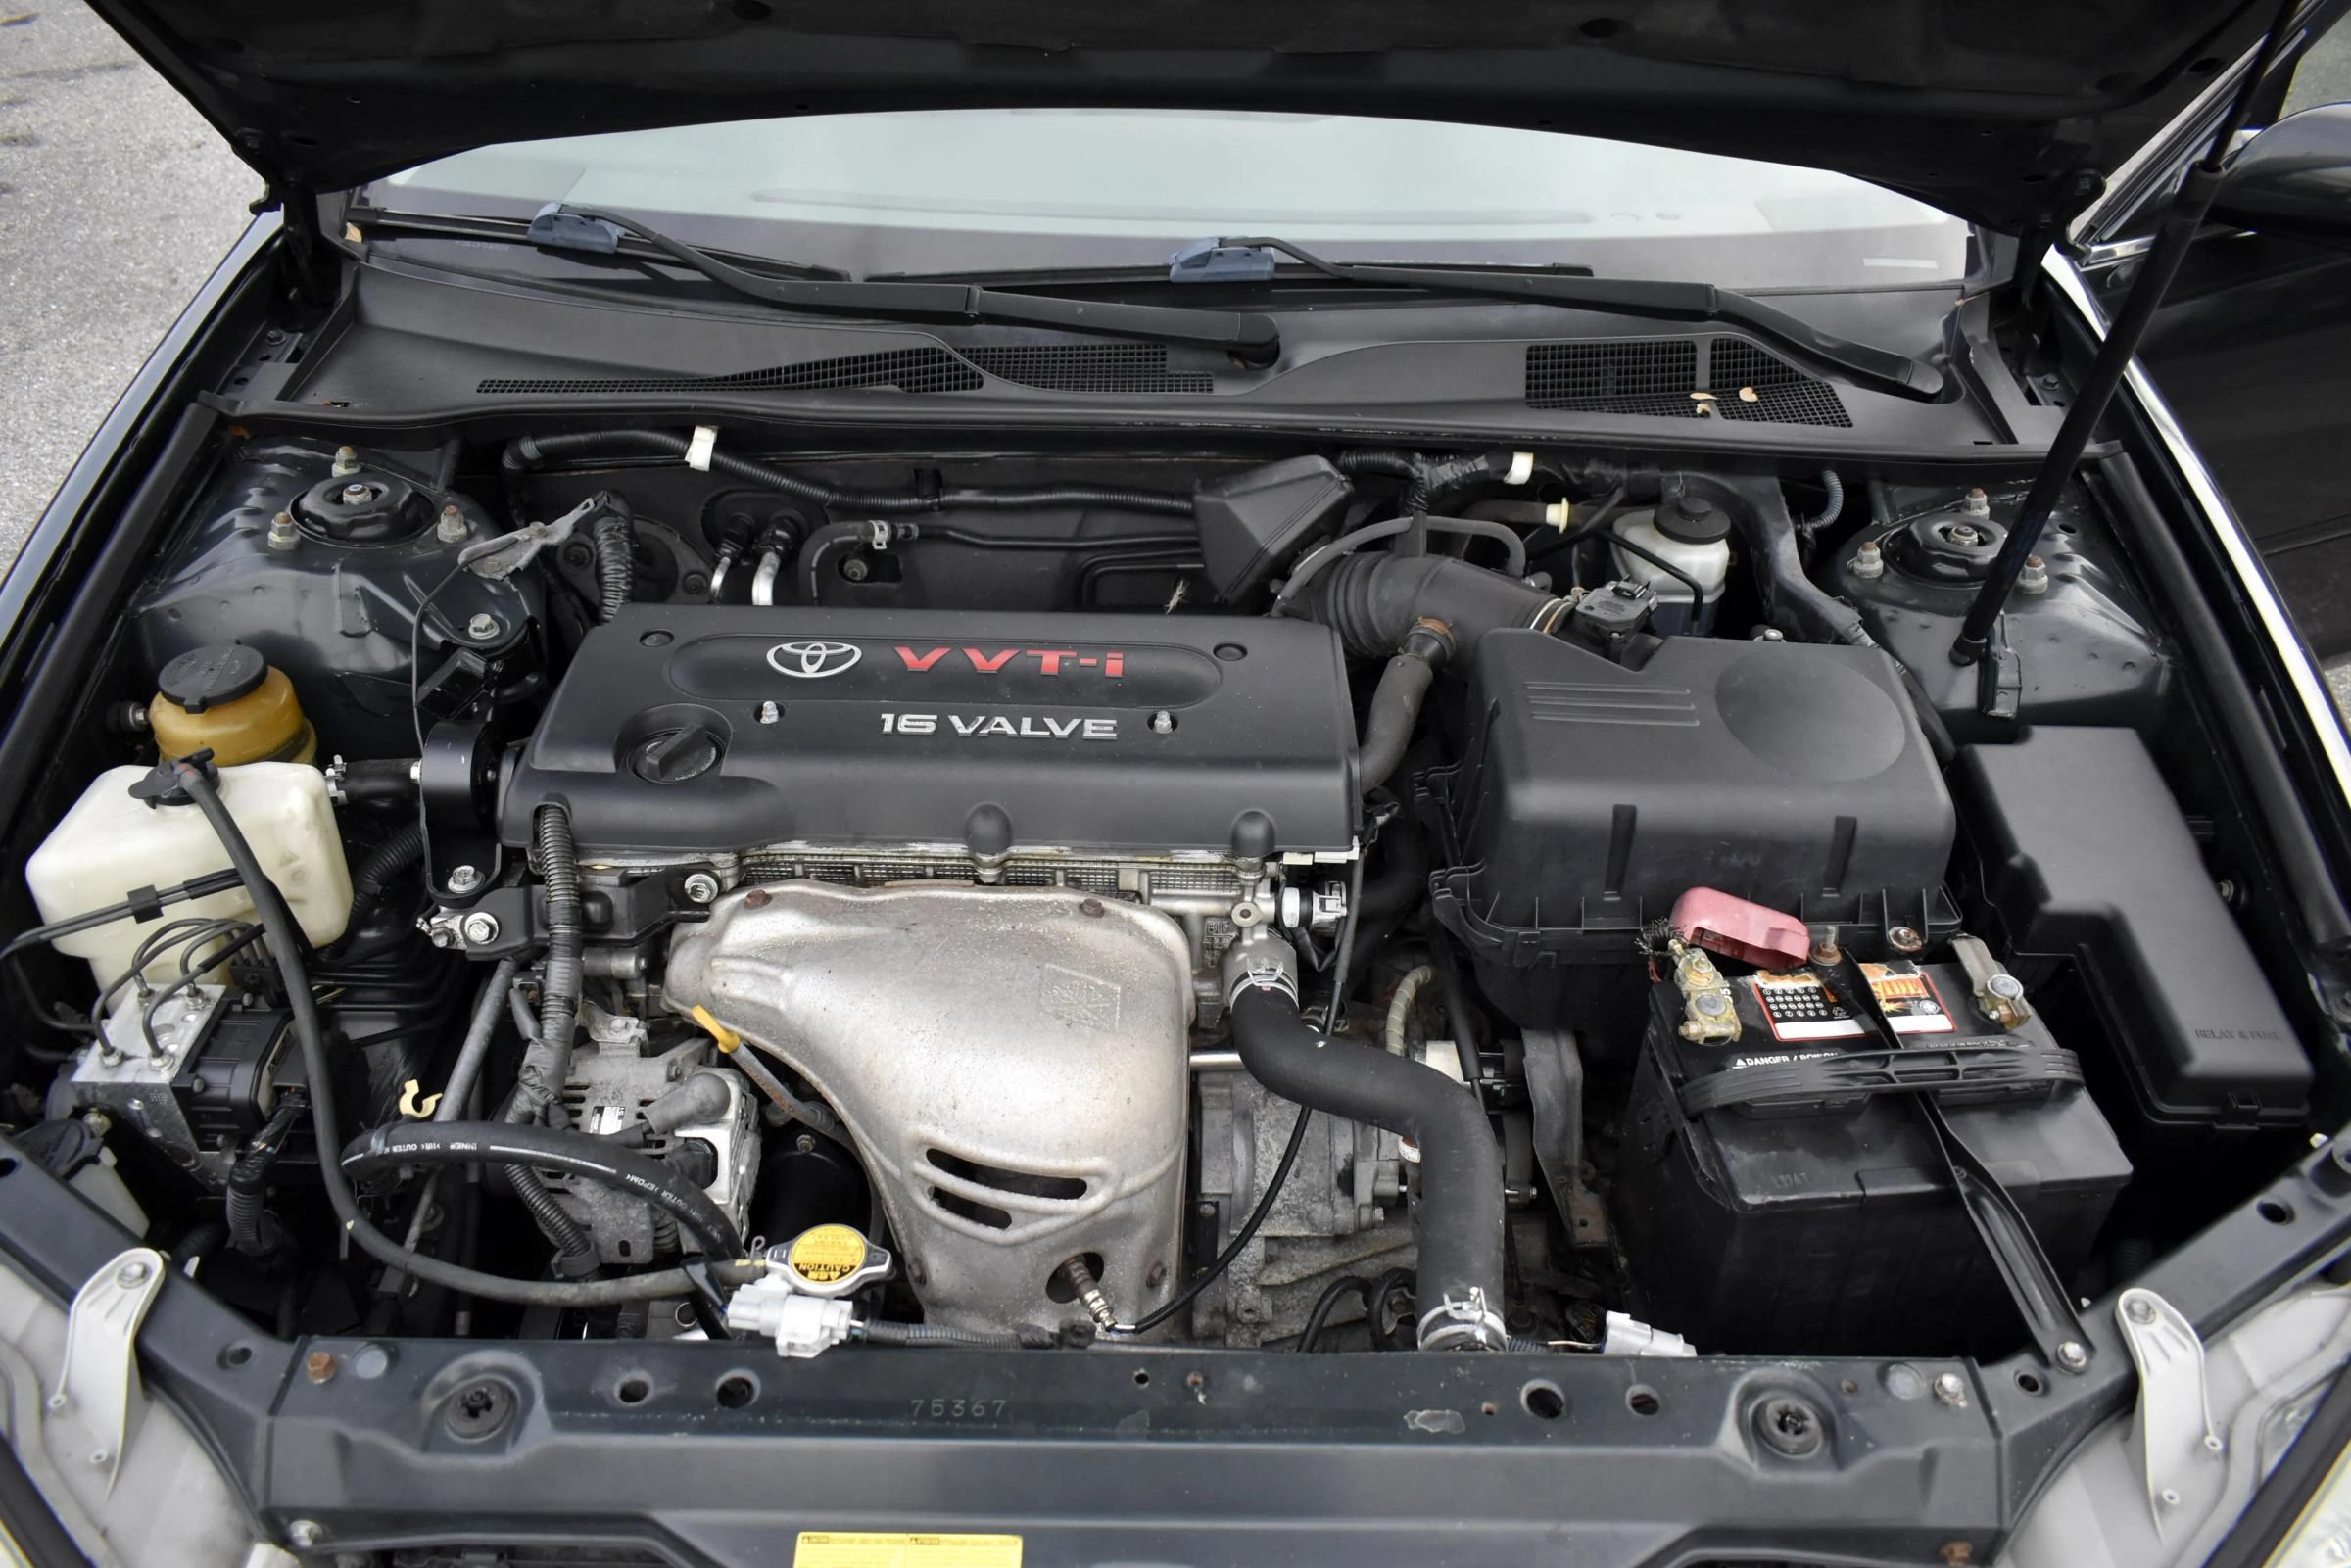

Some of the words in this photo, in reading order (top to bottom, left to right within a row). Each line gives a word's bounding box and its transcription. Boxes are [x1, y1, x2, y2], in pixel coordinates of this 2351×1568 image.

[893, 645, 1124, 678] VVT-i
[881, 713, 938, 735] 16
[947, 714, 1118, 740] VALVE
[2194, 1029, 2234, 1040] RELAY
[393, 1142, 417, 1153] OUTER
[661, 1189, 688, 1209] OUTER
[798, 1262, 851, 1273] CAUTION
[910, 1399, 1007, 1418] 75367
